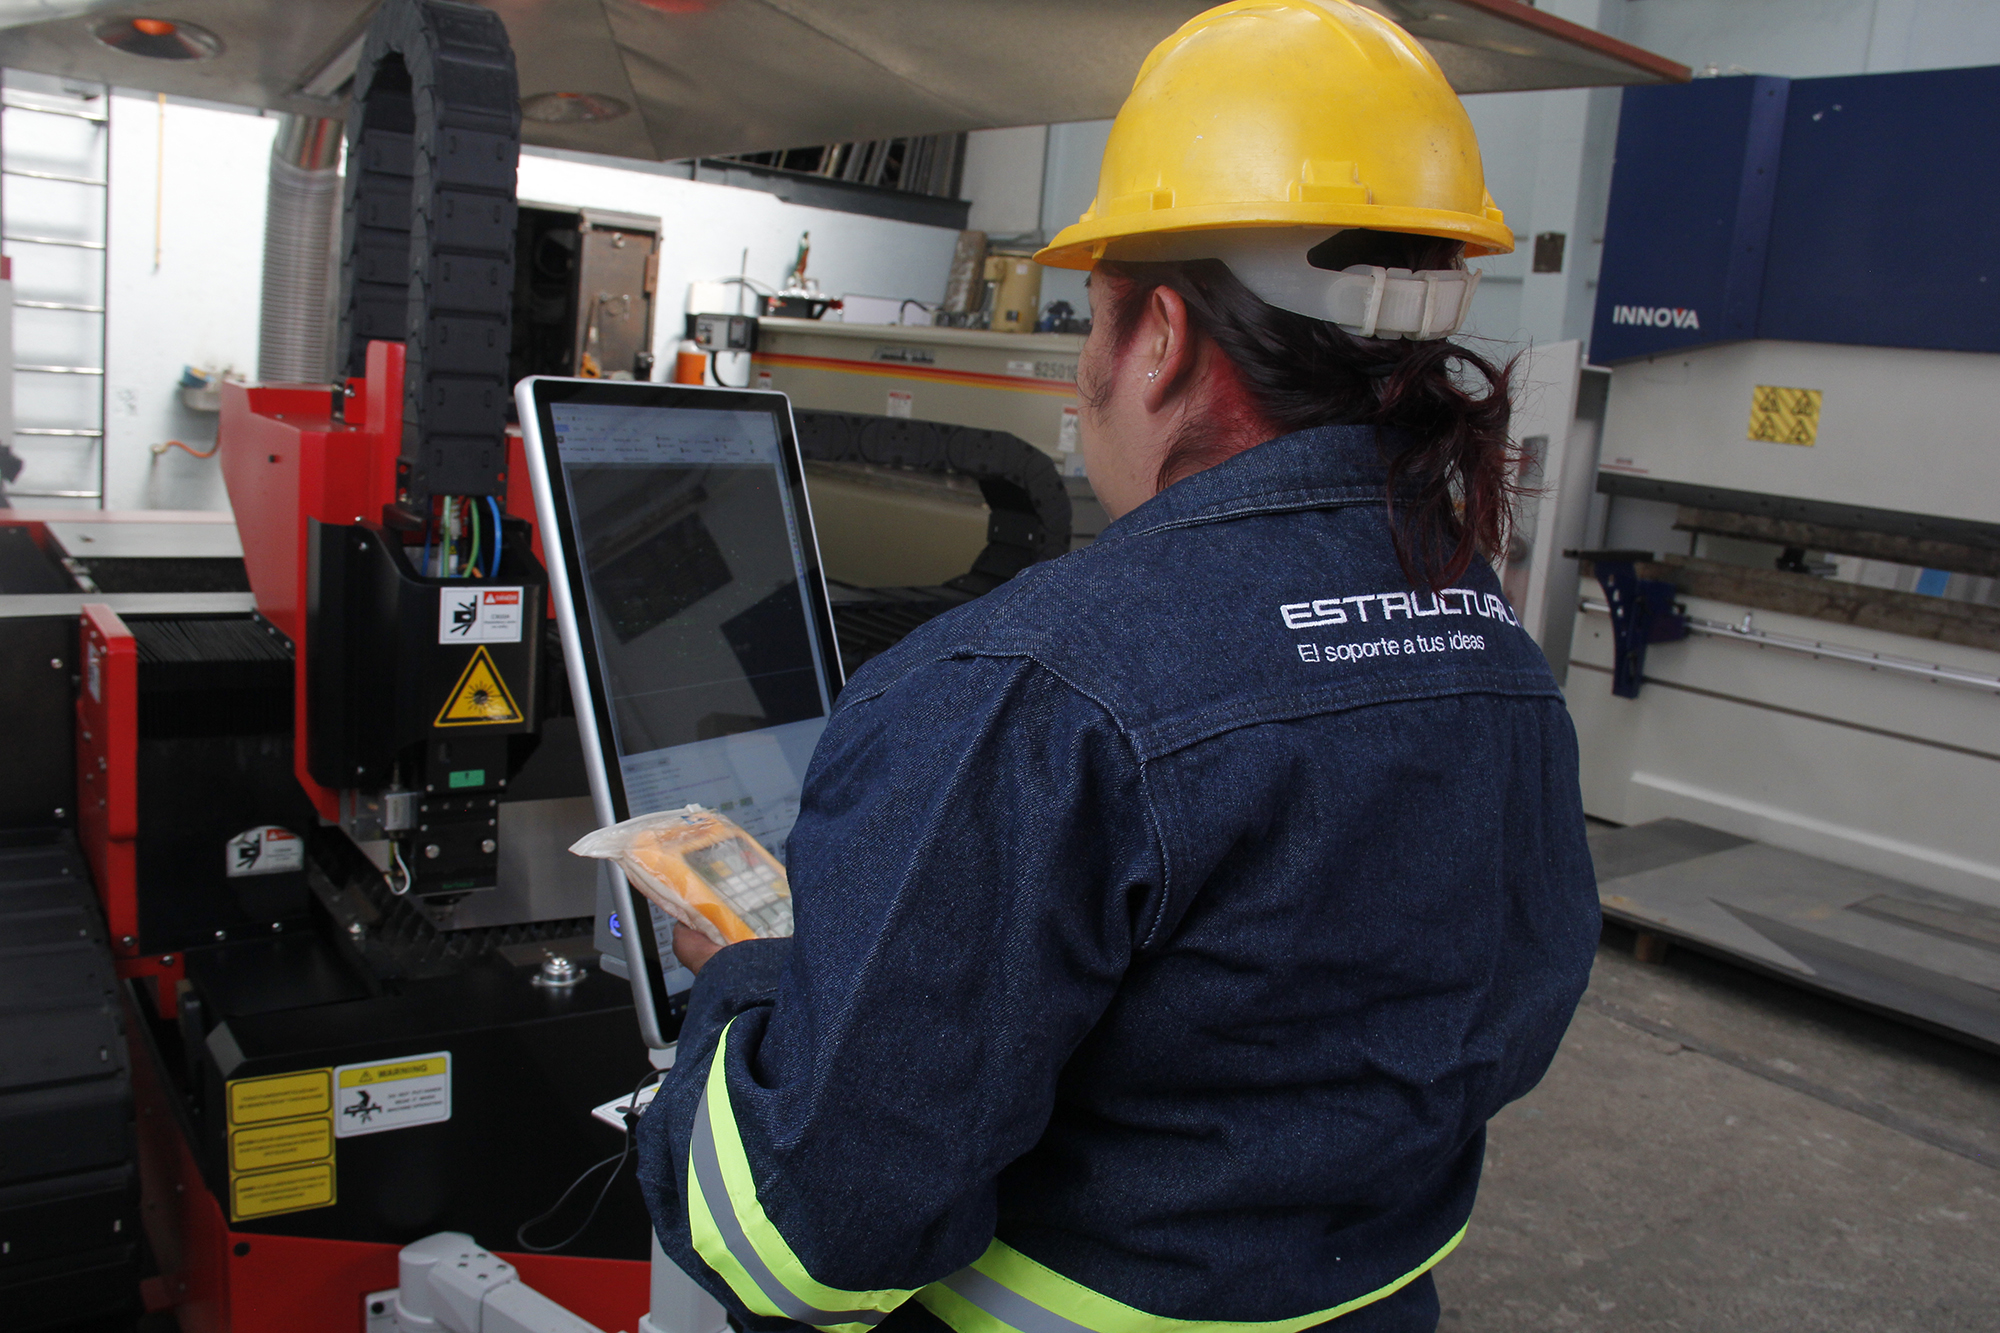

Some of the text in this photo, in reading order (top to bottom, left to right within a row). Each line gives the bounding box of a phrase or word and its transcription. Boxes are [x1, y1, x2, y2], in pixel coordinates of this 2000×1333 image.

[1612, 305, 1699, 330] INNOVA
[1280, 588, 1521, 629] ESTRUCTURAL
[1297, 630, 1485, 663] El soporte a tus ideas
